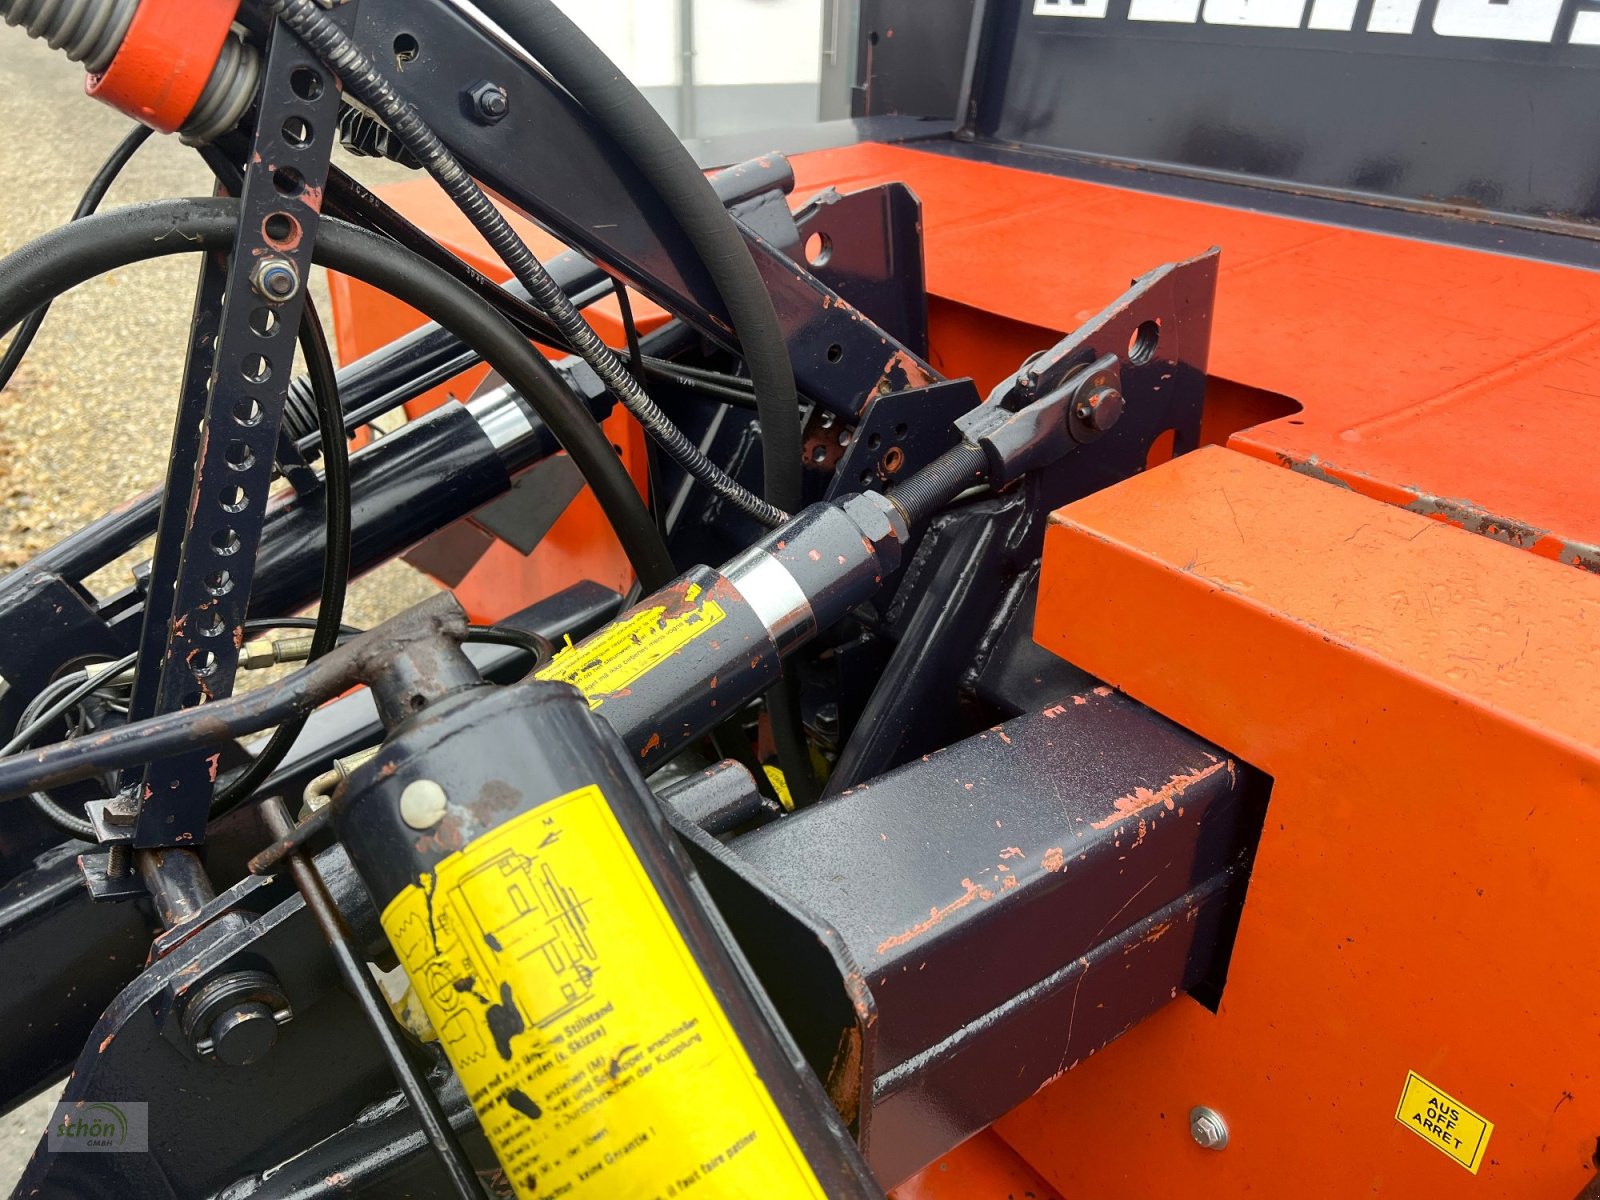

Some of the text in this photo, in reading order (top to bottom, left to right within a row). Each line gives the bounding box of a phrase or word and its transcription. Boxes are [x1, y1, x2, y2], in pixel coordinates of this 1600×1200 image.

[564, 1000, 615, 1037] Stillstand
[566, 1025, 608, 1058] Skizze)
[655, 1032, 703, 1066] Kupplung
[1426, 1107, 1457, 1130] OFF
[1428, 1097, 1460, 1121] AUS
[1412, 1112, 1463, 1150] ARRET
